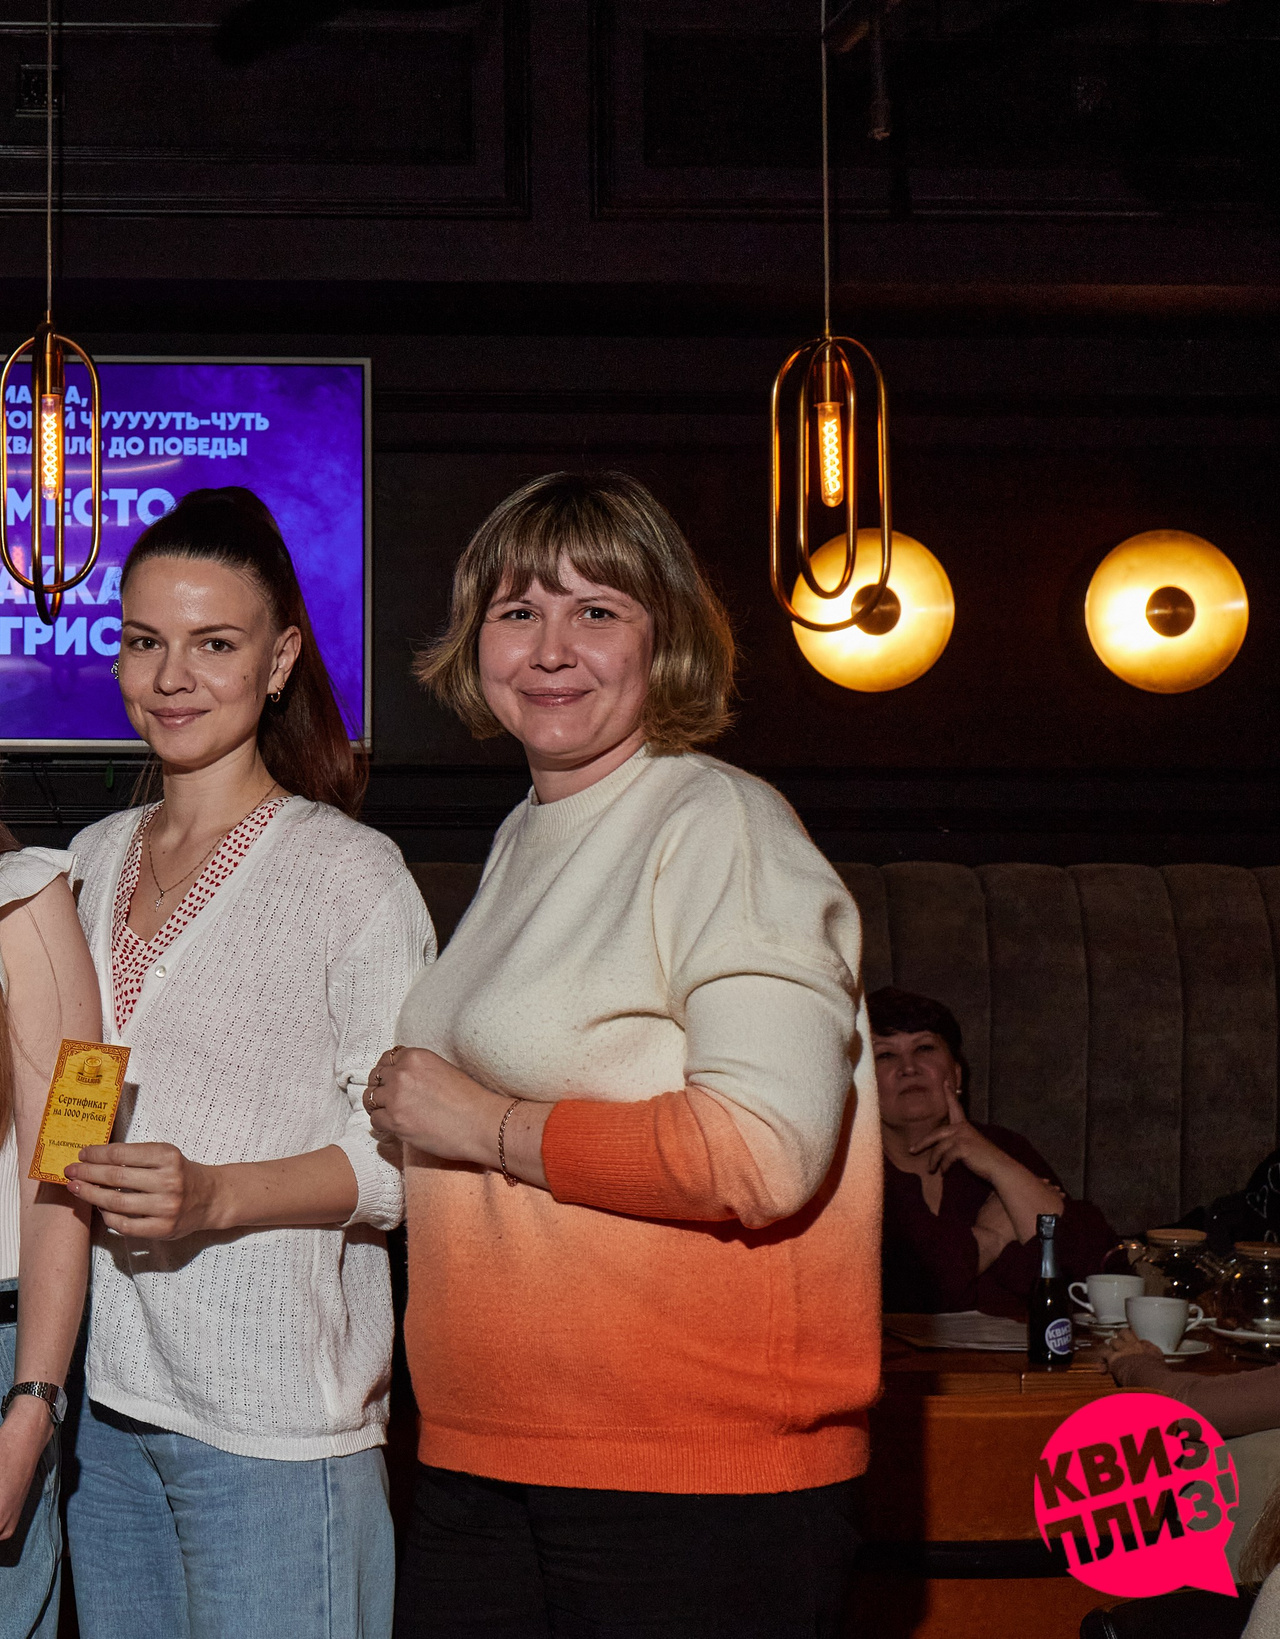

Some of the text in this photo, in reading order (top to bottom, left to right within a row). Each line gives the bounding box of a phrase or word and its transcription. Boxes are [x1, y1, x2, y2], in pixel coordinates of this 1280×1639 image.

[108, 437, 145, 458] ДО
[149, 437, 248, 459] ПОБЕДЫ
[6, 487, 176, 527] МЕСТО
[58, 1094, 108, 1110] Сертификат
[53, 1108, 62, 1116] на
[64, 1108, 81, 1118] 1000
